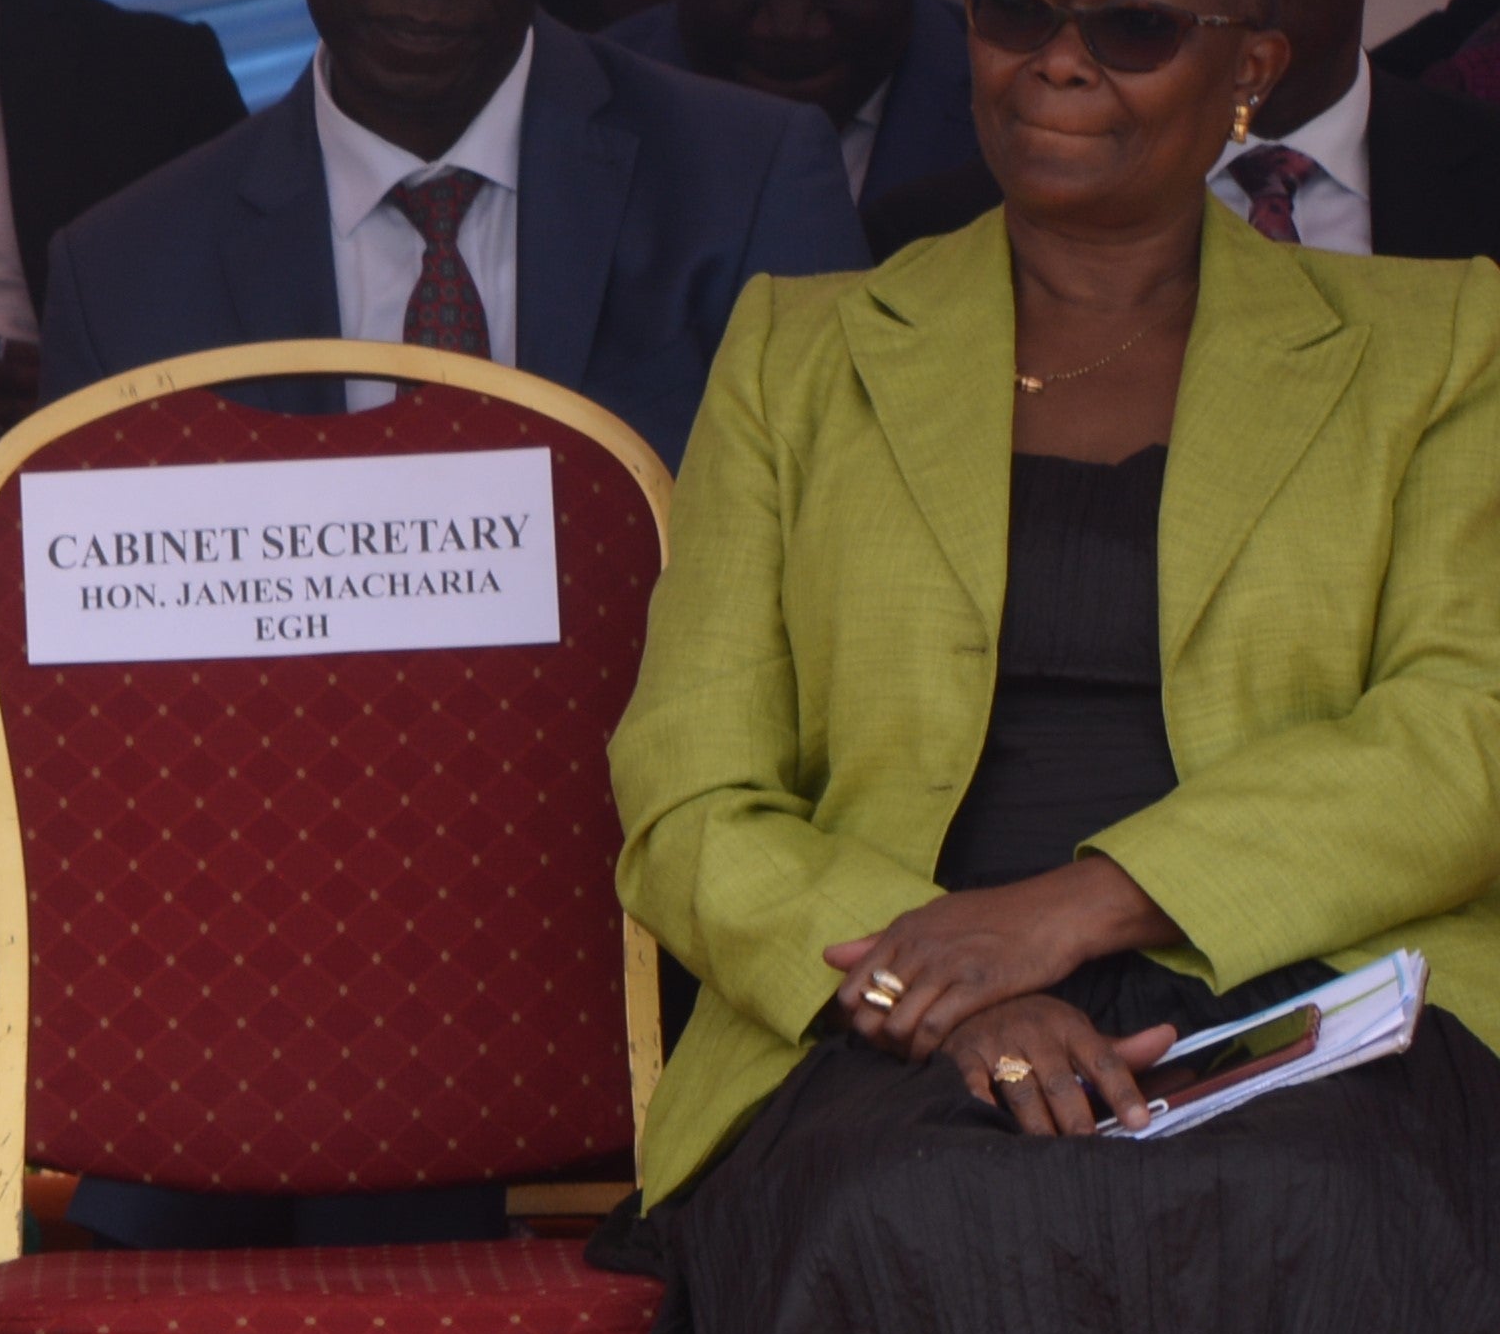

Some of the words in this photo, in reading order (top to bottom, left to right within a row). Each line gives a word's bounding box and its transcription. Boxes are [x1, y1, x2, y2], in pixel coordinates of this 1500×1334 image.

[47, 527, 250, 570] CABINET
[261, 514, 531, 561] SECRETARY
[80, 583, 167, 611] HON.
[175, 576, 295, 608] JAMES
[304, 569, 502, 602] MACHARIA
[254, 614, 331, 643] EGH
